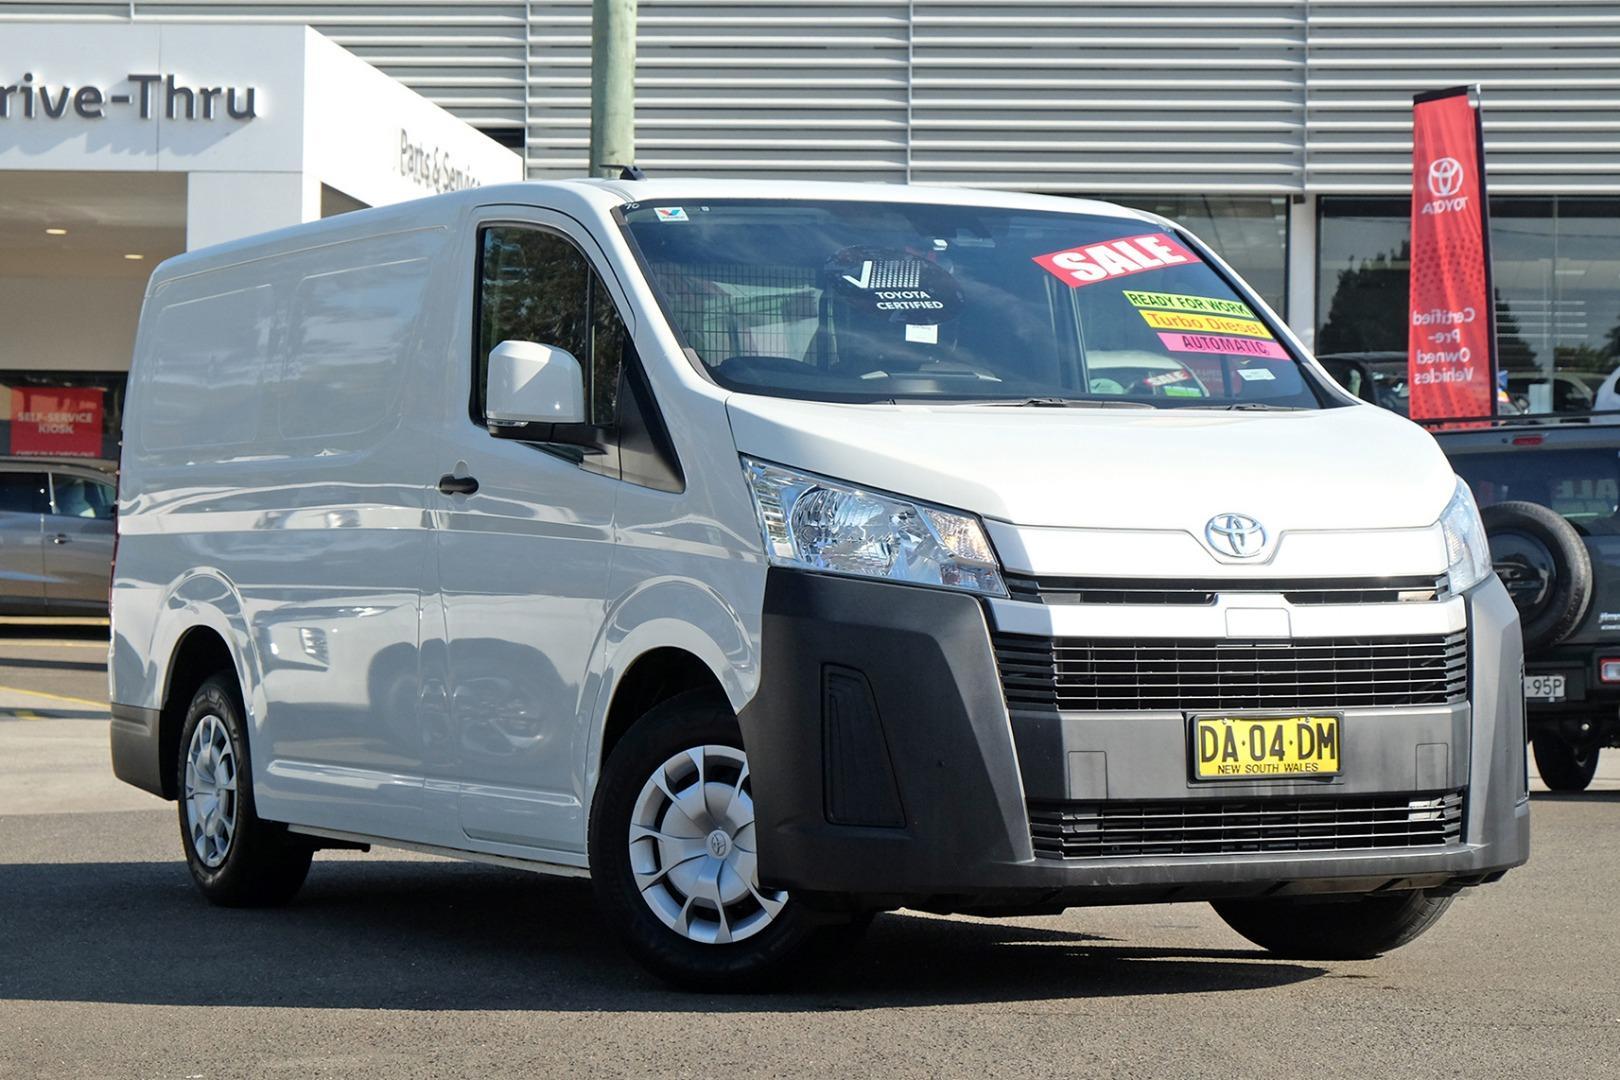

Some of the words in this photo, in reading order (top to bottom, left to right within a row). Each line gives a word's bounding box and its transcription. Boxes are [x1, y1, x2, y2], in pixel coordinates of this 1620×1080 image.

[400, 128, 430, 188] Parts
[443, 151, 481, 192] Servi
[1051, 236, 1188, 281] SALE
[875, 291, 930, 299] TOYOTA
[1128, 293, 1173, 307] READY
[1176, 297, 1208, 309] FOR
[1210, 302, 1249, 315] WORK
[876, 301, 944, 310] CERTIFIED
[1147, 313, 1202, 329] Turbo
[1206, 318, 1263, 335] Diesel
[1181, 335, 1269, 355] AUTOMATIC
[38, 423, 74, 434] KIOSK
[1217, 765, 1241, 774] NEW
[1245, 763, 1280, 773] SOUTH
[1283, 762, 1319, 772] WALES
